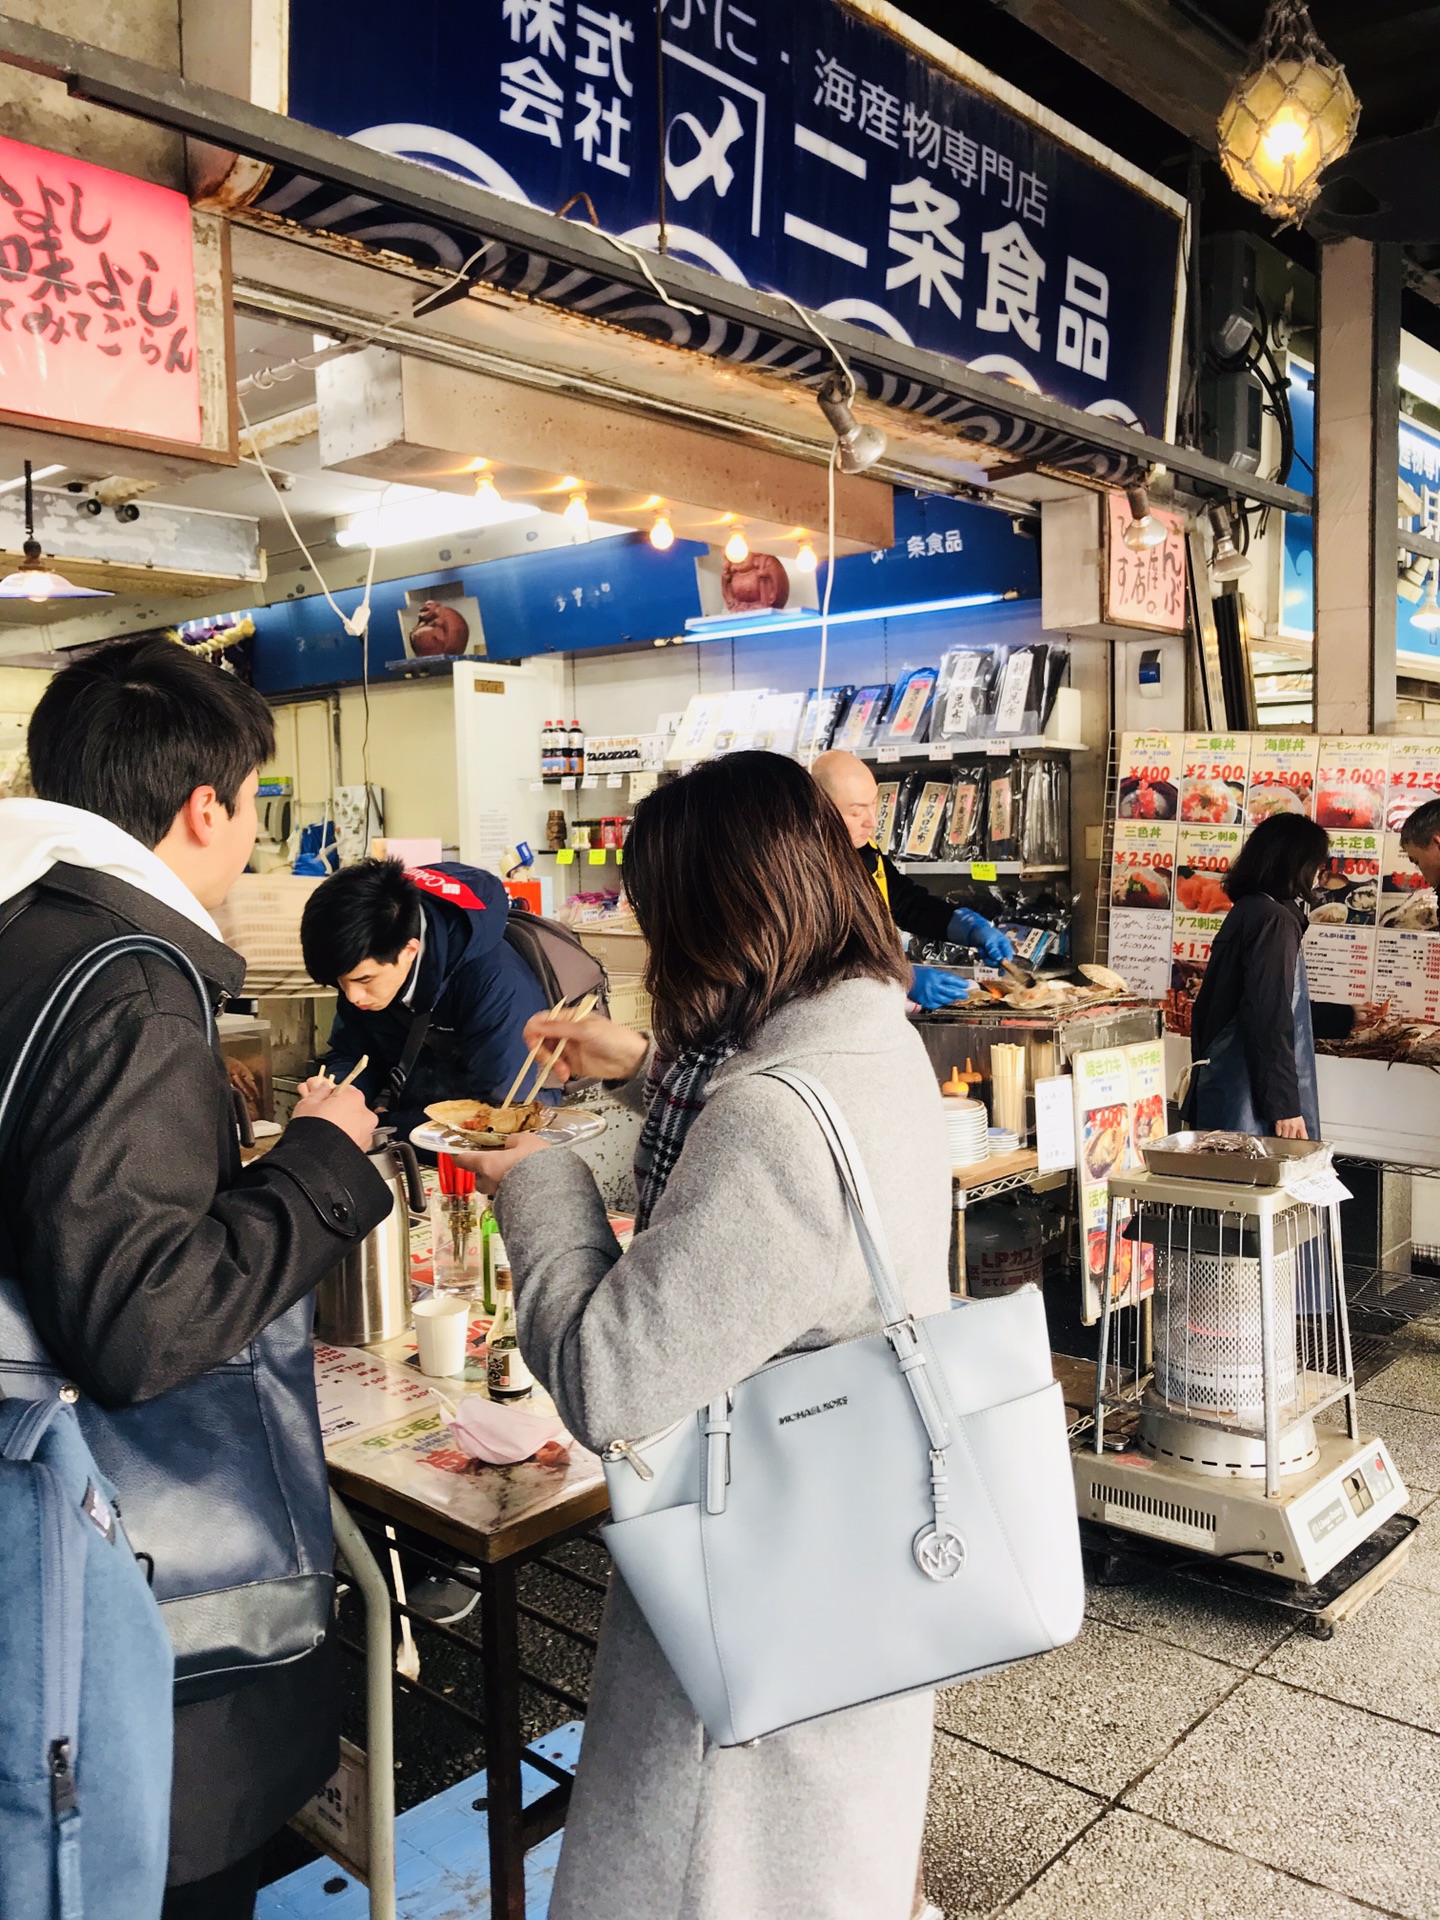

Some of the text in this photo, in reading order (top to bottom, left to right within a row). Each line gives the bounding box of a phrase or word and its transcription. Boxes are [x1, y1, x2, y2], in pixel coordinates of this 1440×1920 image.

[499, 56, 632, 178] 会社
[783, 124, 1110, 382] 二条食品
[1264, 738, 1306, 752] 海鮮丼
[1130, 766, 1171, 782] ¥400
[1125, 826, 1162, 839] 三色丼
[1180, 830, 1238, 842] サーモン刺身
[1186, 855, 1230, 873] ¥500
[981, 1246, 1034, 1269] LPガス
